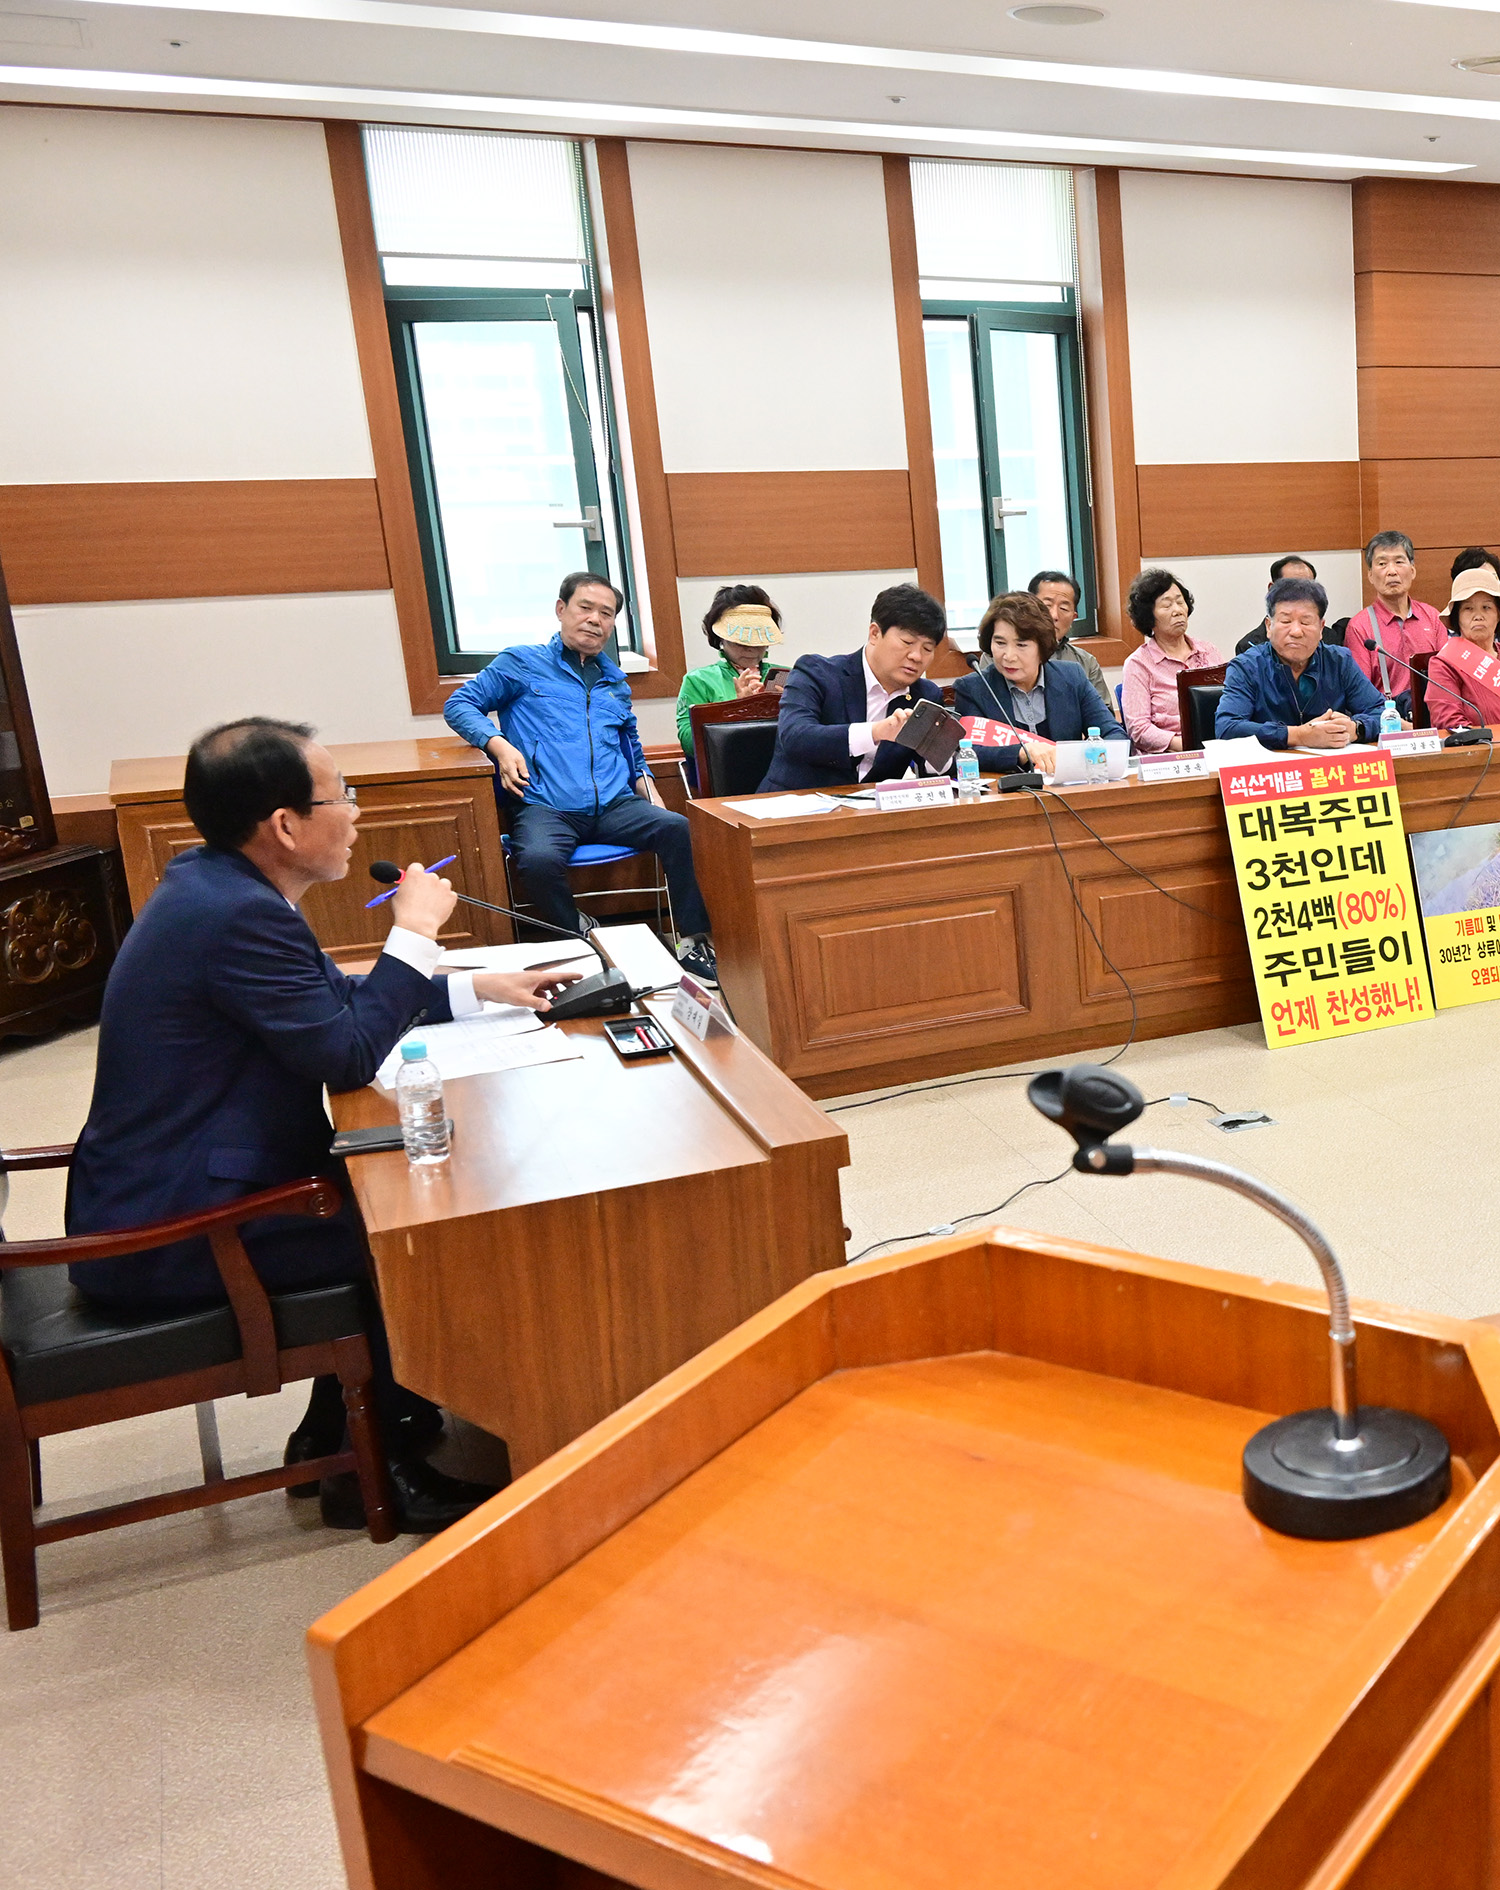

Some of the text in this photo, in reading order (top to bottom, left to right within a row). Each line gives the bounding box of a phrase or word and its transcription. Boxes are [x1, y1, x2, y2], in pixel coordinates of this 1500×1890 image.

[728, 624, 774, 642] VOTE
[1230, 760, 1389, 798] 석산개발 결사 반대
[1238, 792, 1394, 842] 대복주민
[1246, 840, 1386, 891] 3천인데
[1254, 883, 1406, 940] 2천4백(80%)
[1454, 916, 1484, 937] 기름띠
[1486, 915, 1496, 932] 및
[1264, 931, 1413, 988] 주민들이
[1439, 943, 1472, 964] 30년간
[1271, 976, 1424, 1037] 언제 찬성했냐!
